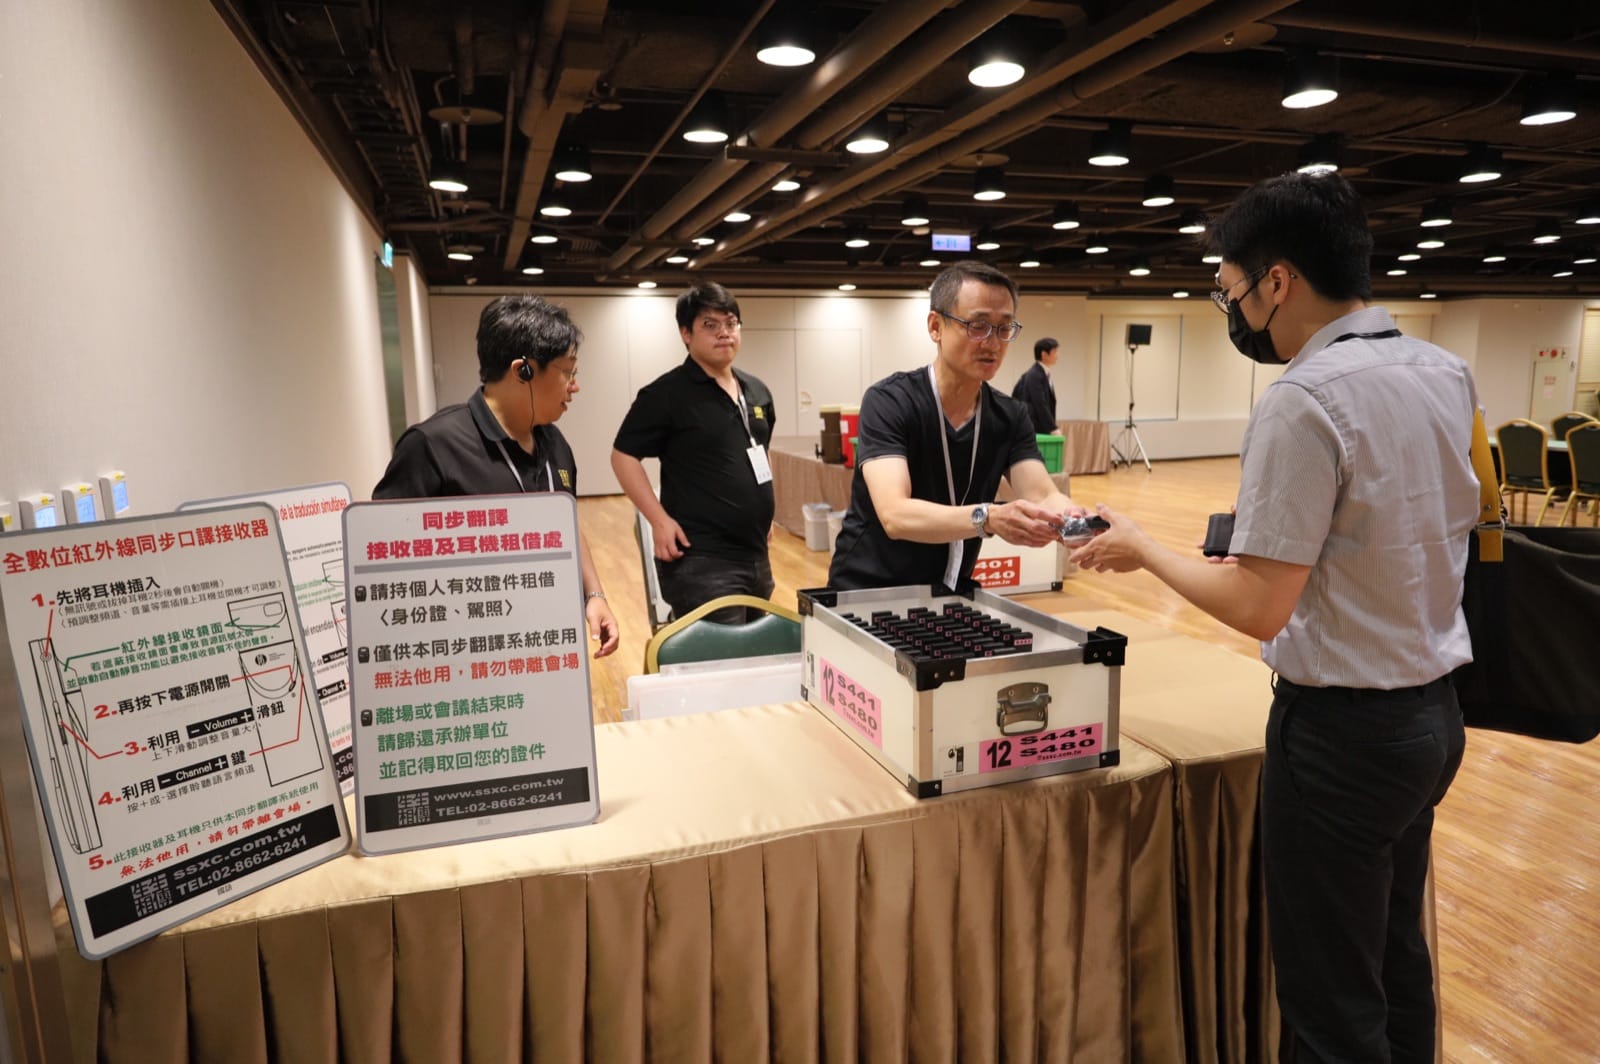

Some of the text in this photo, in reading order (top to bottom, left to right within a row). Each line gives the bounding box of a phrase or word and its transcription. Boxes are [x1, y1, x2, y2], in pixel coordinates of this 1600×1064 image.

[423, 508, 509, 530] 同步翻譯
[2, 519, 269, 574] 全數位紅外線同步口譯接收器
[367, 531, 563, 560] 接收器及耳機租借處
[972, 570, 1015, 580] 440
[974, 559, 1014, 570] 401
[370, 571, 555, 601] 請持個人有效證件租借
[121, 622, 223, 654] 紅外線接收鏡面
[373, 628, 577, 663] 僅供本同步翻譯系統使用
[374, 653, 579, 689] 無法他用，請勿帶離會場
[823, 665, 836, 707] 12
[837, 674, 876, 711] S441
[203, 717, 239, 731] Volume
[256, 700, 285, 720] 滑鈕
[376, 692, 525, 726] 離場或會議結束時
[837, 692, 878, 731] S480
[377, 721, 509, 752] 請歸還承辦單位
[1020, 727, 1093, 745] S441
[1020, 738, 1096, 757] S480
[175, 763, 213, 781] Channel
[231, 750, 247, 766] 鍵
[379, 742, 546, 780] 並記得取回您的證件
[987, 740, 1012, 769] 12
[433, 776, 565, 802] www.ssxc.com.tw
[435, 791, 563, 817] TEL:02-8662-6241
[174, 822, 302, 880] ssxc.com.tw
[176, 835, 307, 897] TEL:02-8662-6241
